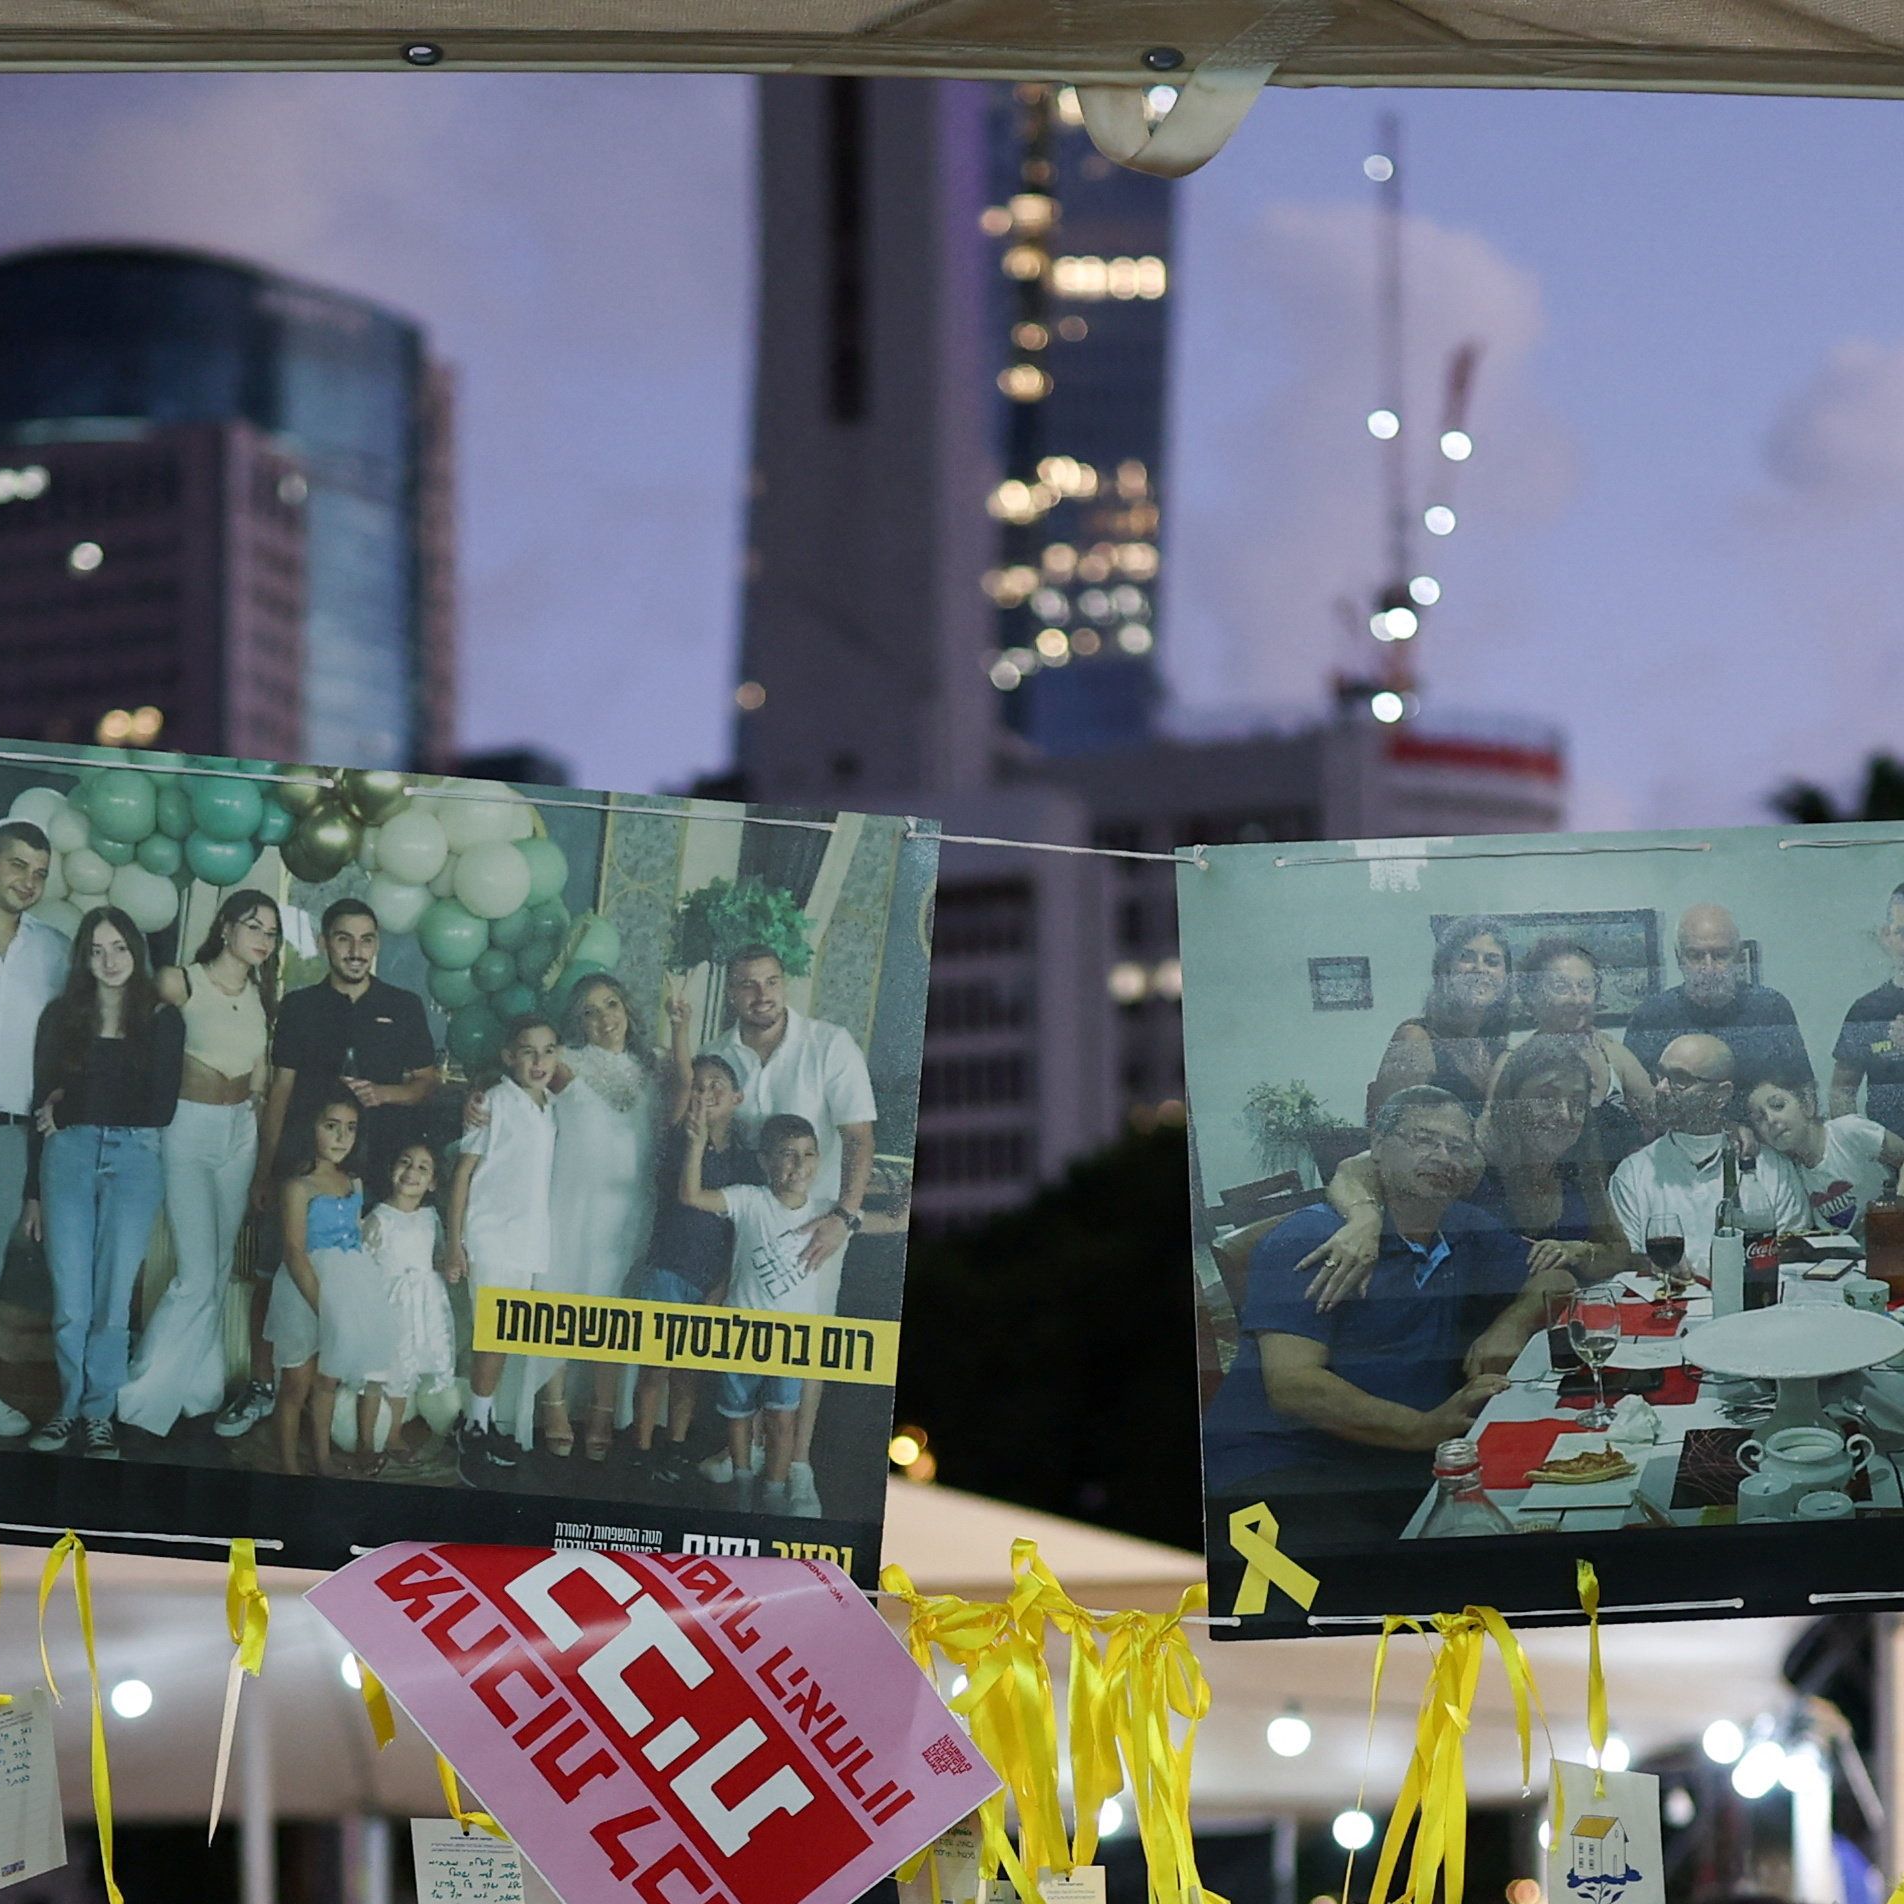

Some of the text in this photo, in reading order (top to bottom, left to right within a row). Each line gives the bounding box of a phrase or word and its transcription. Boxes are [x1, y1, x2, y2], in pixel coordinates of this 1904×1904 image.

[496, 1299, 874, 1372] רום ברסלבסקי ומשפחתו
[555, 1522, 662, 1546] מטה המשפחות להחזרת
[375, 1553, 620, 1805] מחכות
[756, 1645, 915, 1826] האחרון
